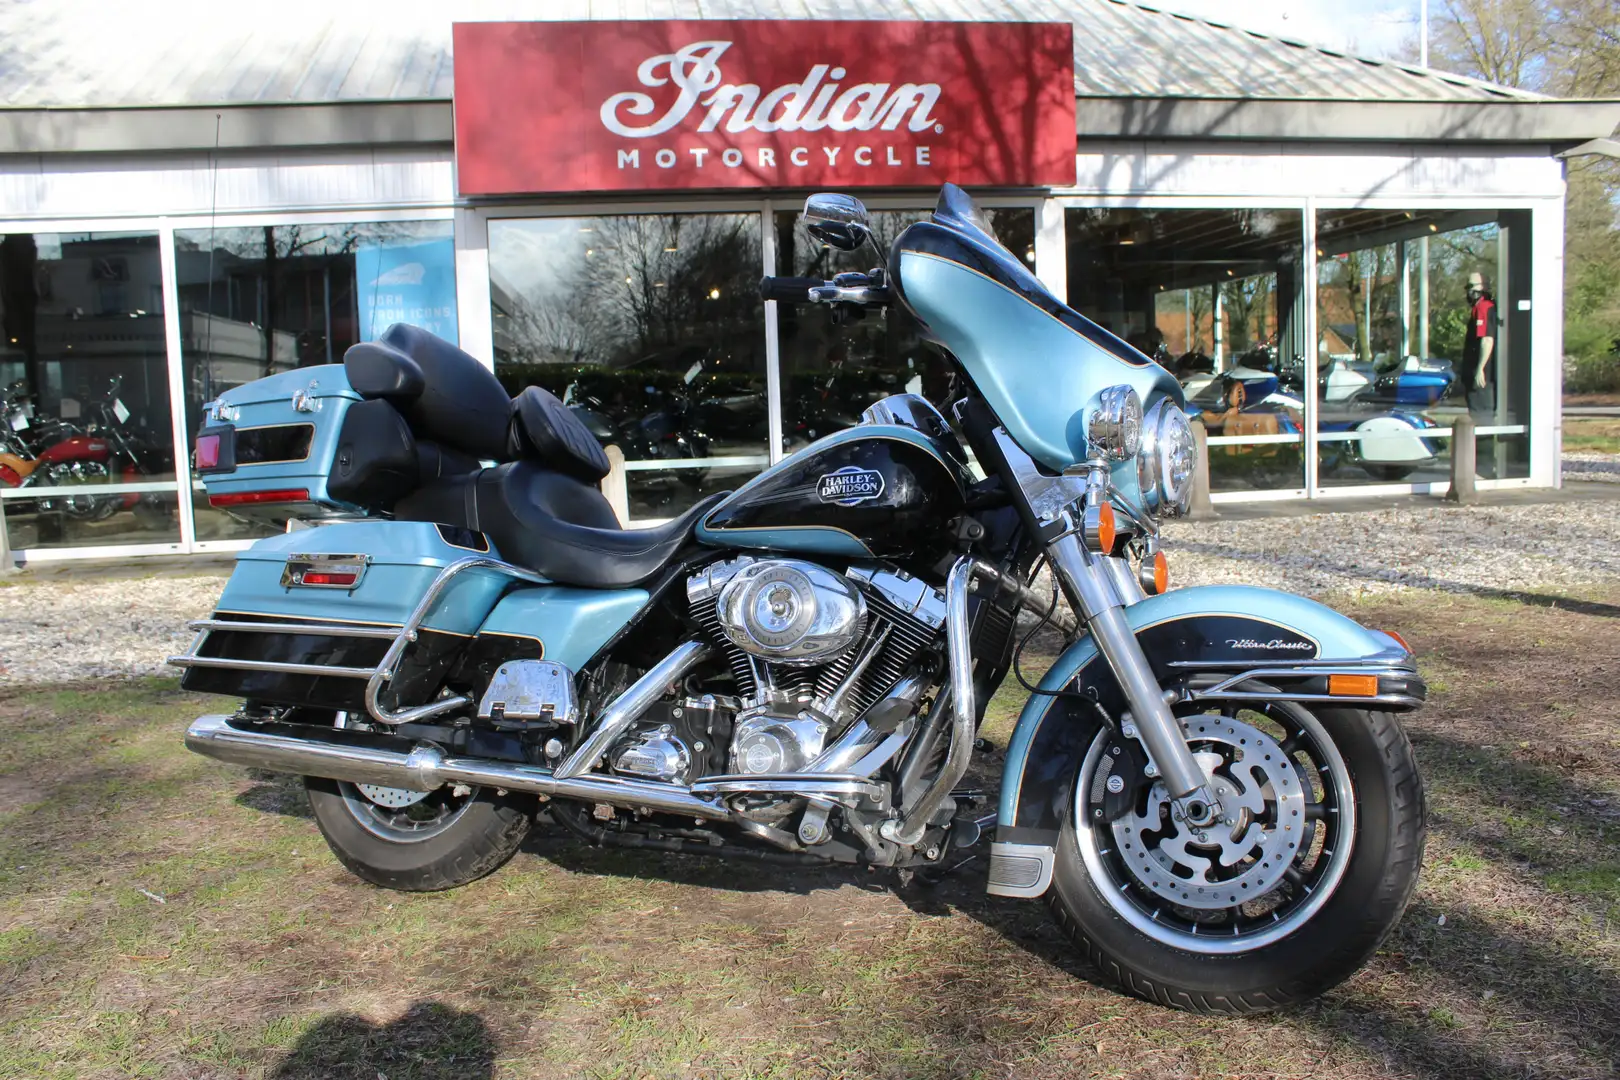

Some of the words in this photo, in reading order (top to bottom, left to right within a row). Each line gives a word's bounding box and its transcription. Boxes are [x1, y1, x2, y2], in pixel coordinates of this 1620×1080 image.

[600, 41, 941, 137] Indian
[617, 147, 931, 169] MOTORCYCLE
[825, 474, 875, 486] HARLEY-
[822, 483, 878, 496] DAVIDSON
[1266, 639, 1313, 649] Classic
